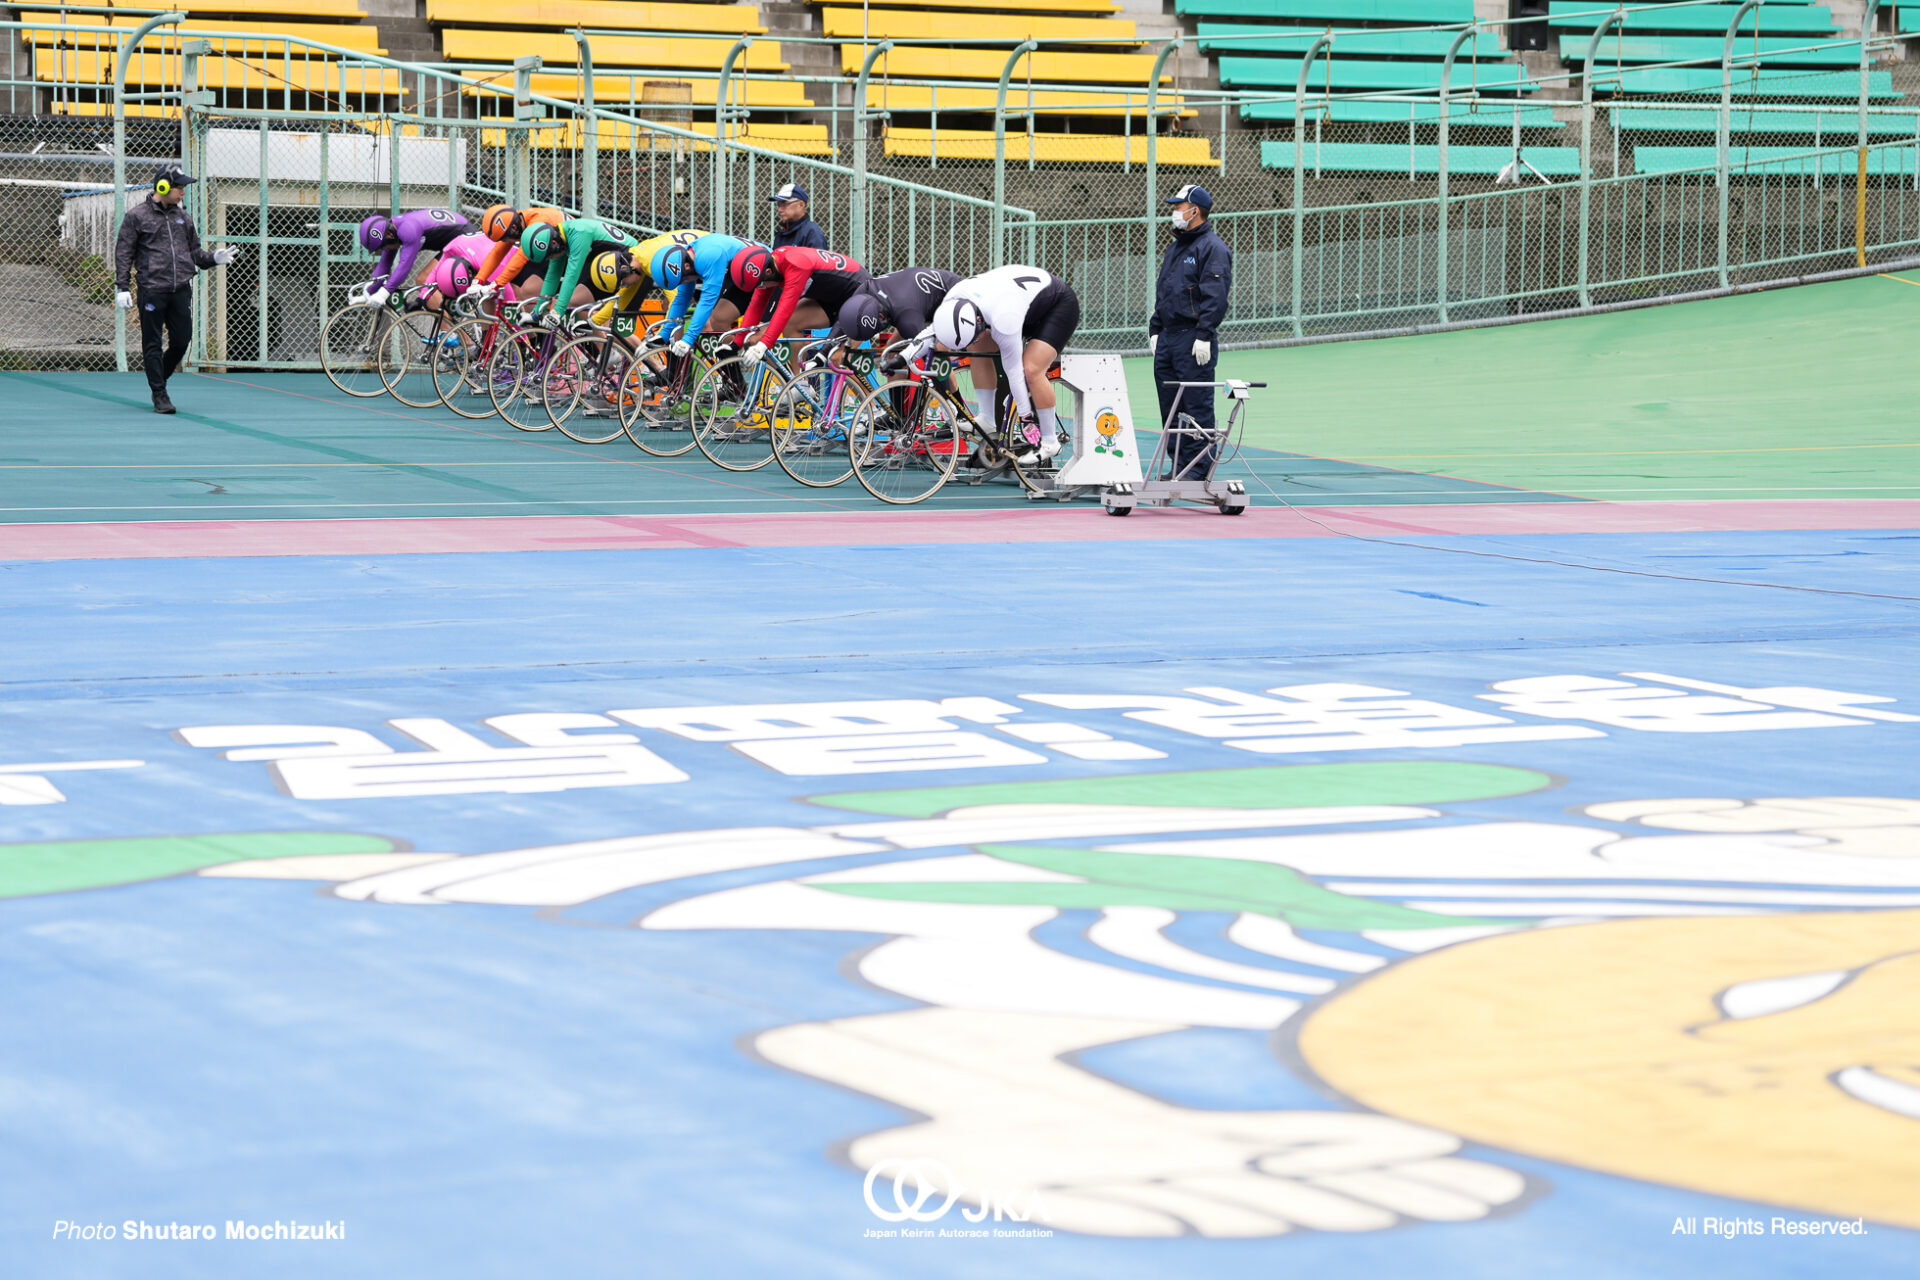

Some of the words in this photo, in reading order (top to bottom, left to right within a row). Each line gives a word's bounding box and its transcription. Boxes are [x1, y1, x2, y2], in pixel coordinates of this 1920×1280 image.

[429, 208, 456, 224] 9
[495, 216, 507, 231] 7
[370, 228, 383, 240] 9
[601, 221, 625, 242] 6
[671, 232, 699, 246] 5
[534, 239, 547, 251] 6
[816, 249, 846, 270] 3
[600, 264, 615, 275] 5
[667, 262, 682, 277] 4
[746, 262, 761, 278] 3
[455, 277, 467, 285] 8
[915, 270, 947, 294] 2
[617, 317, 634, 333] 54
[861, 315, 877, 329] 2
[960, 317, 975, 327] 1
[701, 335, 719, 353] 66
[771, 342, 790, 360] 30
[852, 355, 871, 373] 46
[929, 359, 950, 377] 50
[0, 671, 1920, 806] 伊東温泉
